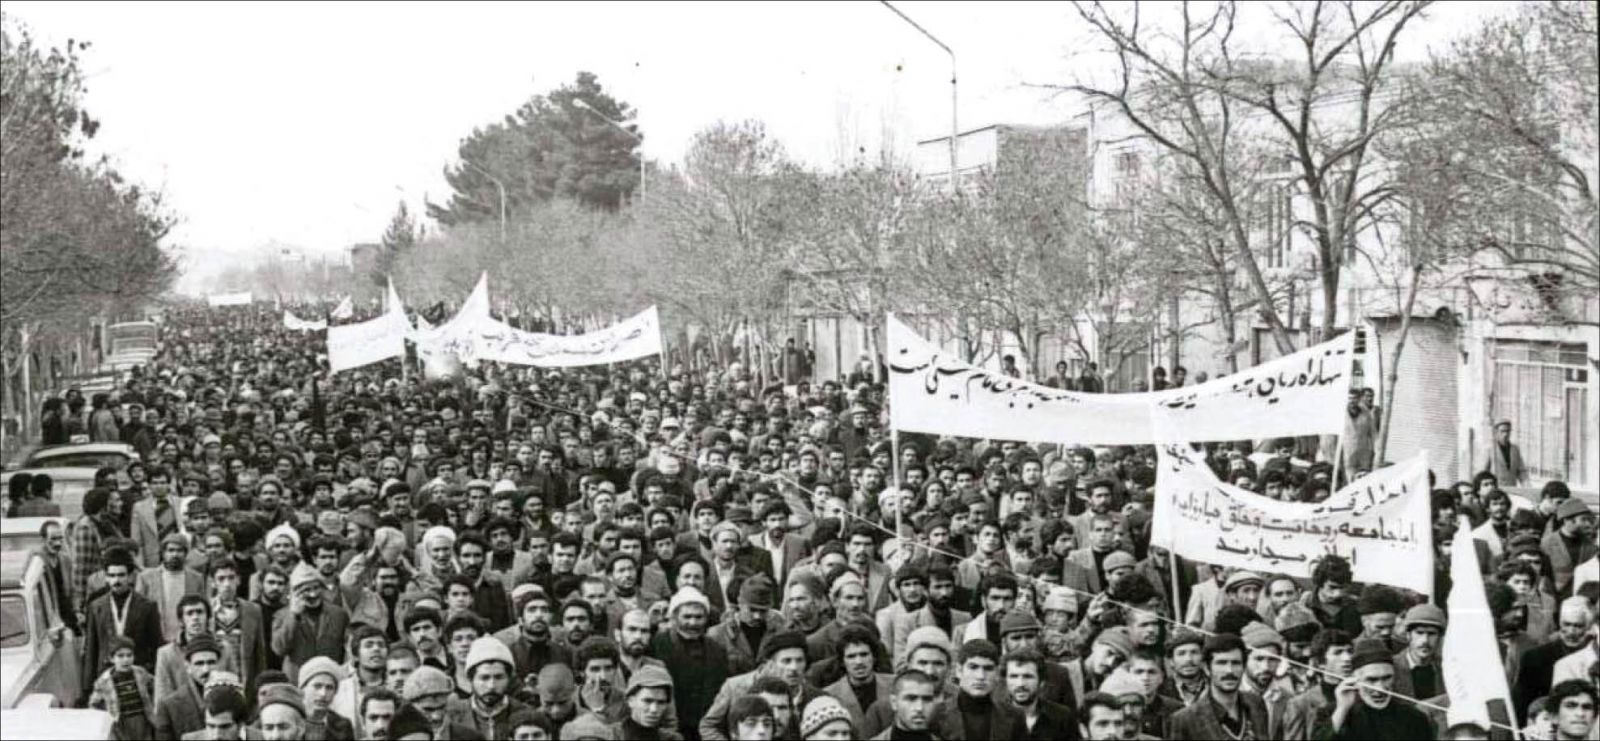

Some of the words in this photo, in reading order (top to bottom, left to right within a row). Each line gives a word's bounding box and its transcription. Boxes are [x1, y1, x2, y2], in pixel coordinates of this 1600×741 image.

[1298, 358, 1319, 387] راه
[1320, 349, 1347, 386] تنها
[1262, 515, 1338, 543] روحانیت
[1338, 516, 1397, 548] جامعه
